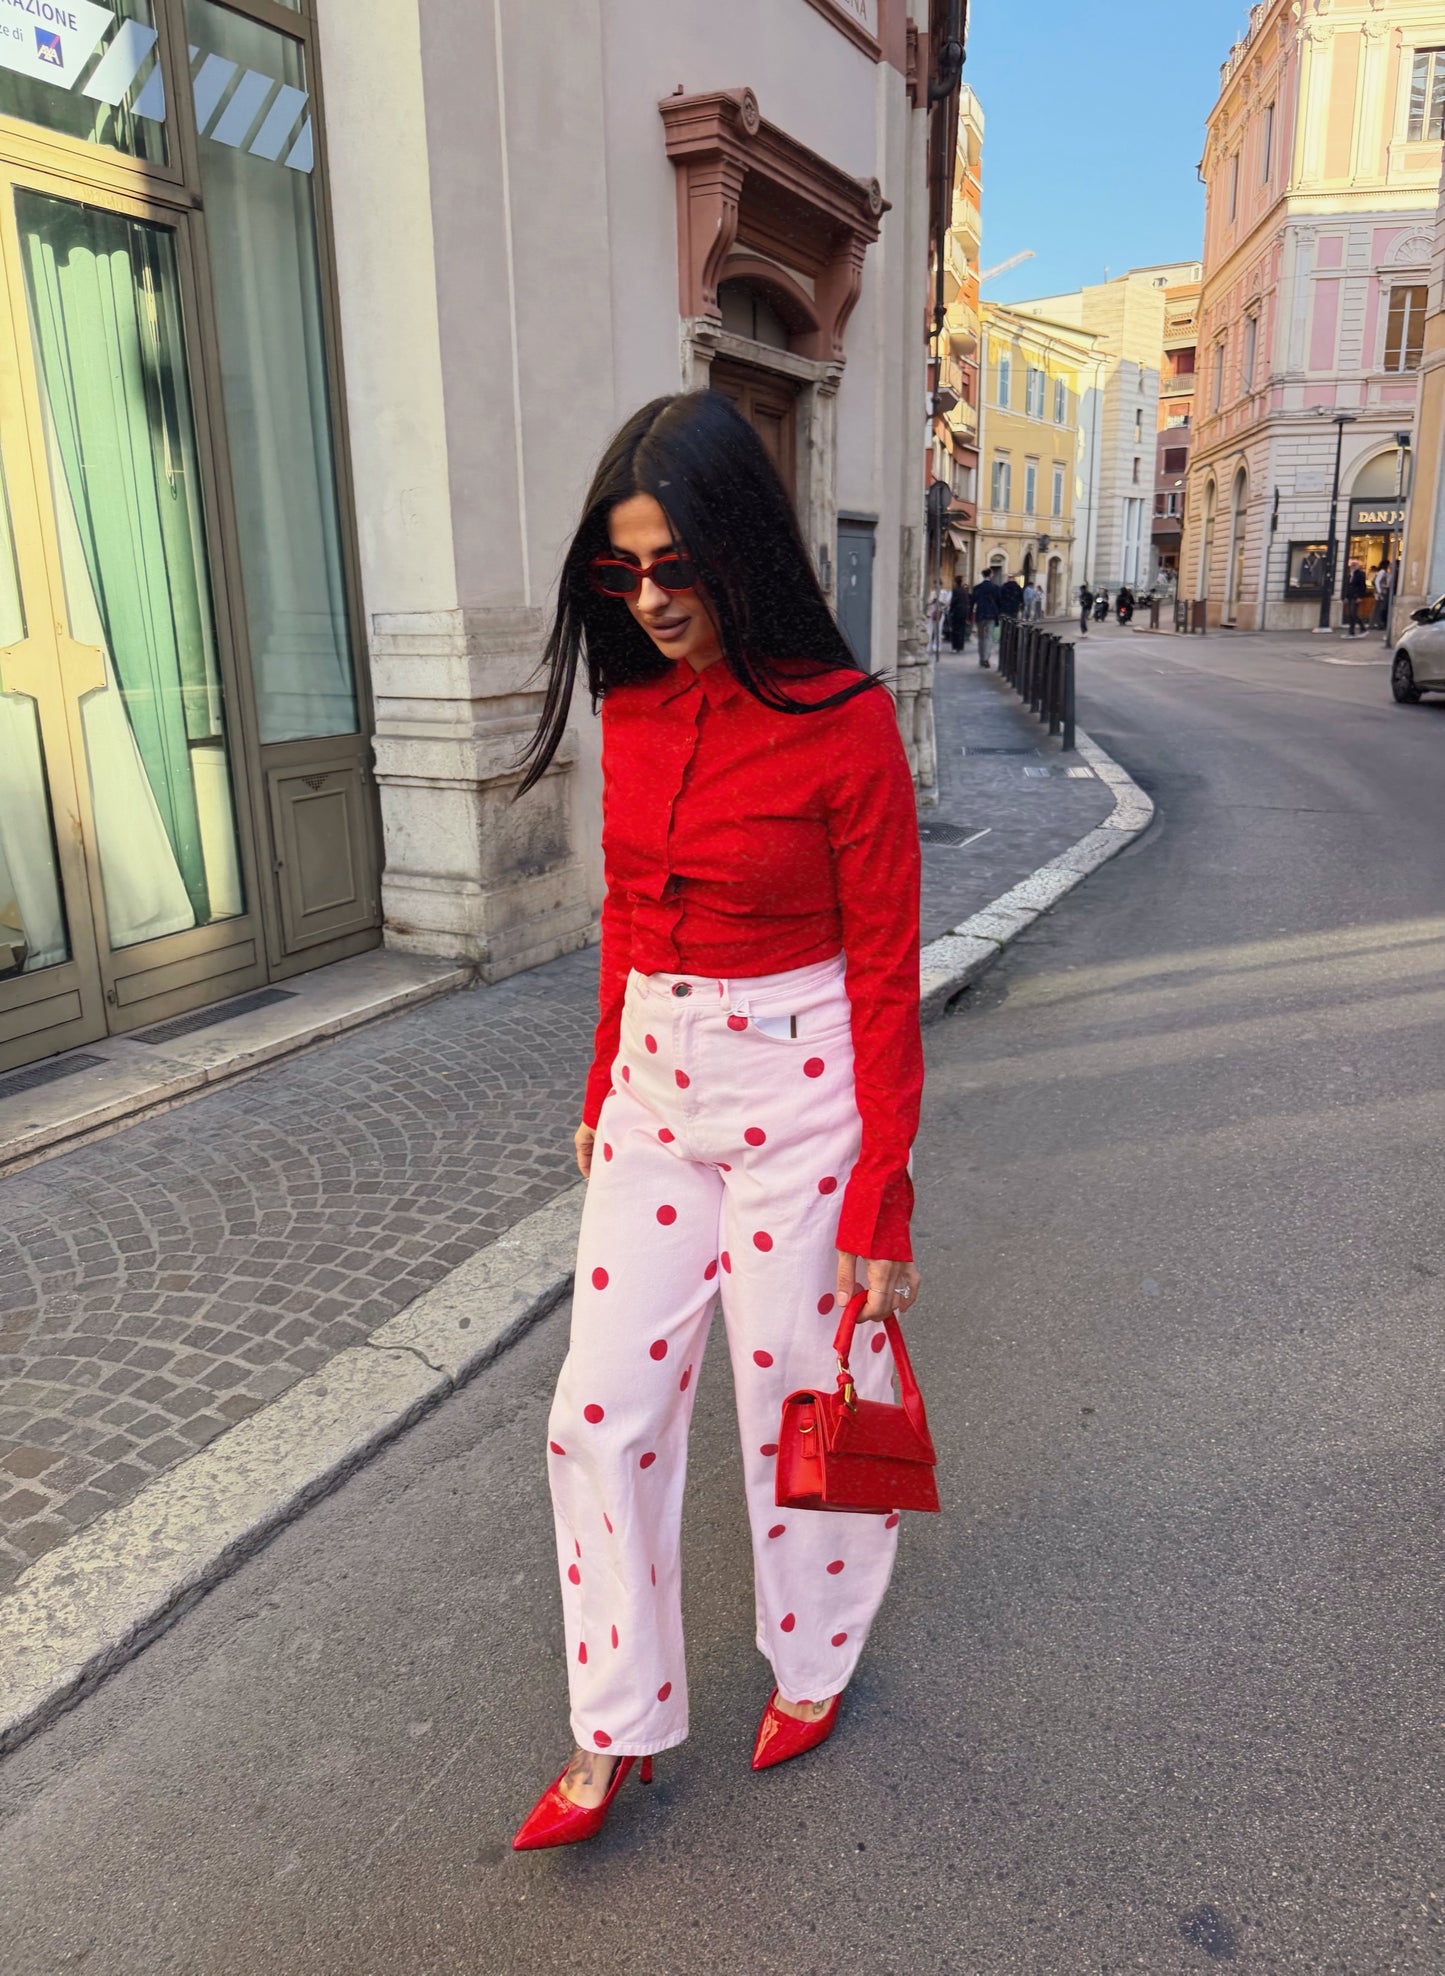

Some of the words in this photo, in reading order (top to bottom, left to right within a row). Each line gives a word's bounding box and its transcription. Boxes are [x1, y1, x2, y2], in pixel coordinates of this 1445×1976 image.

[12, 27, 24, 42] di
[38, 44, 61, 66] AXA
[1358, 510, 1388, 523] DAN
